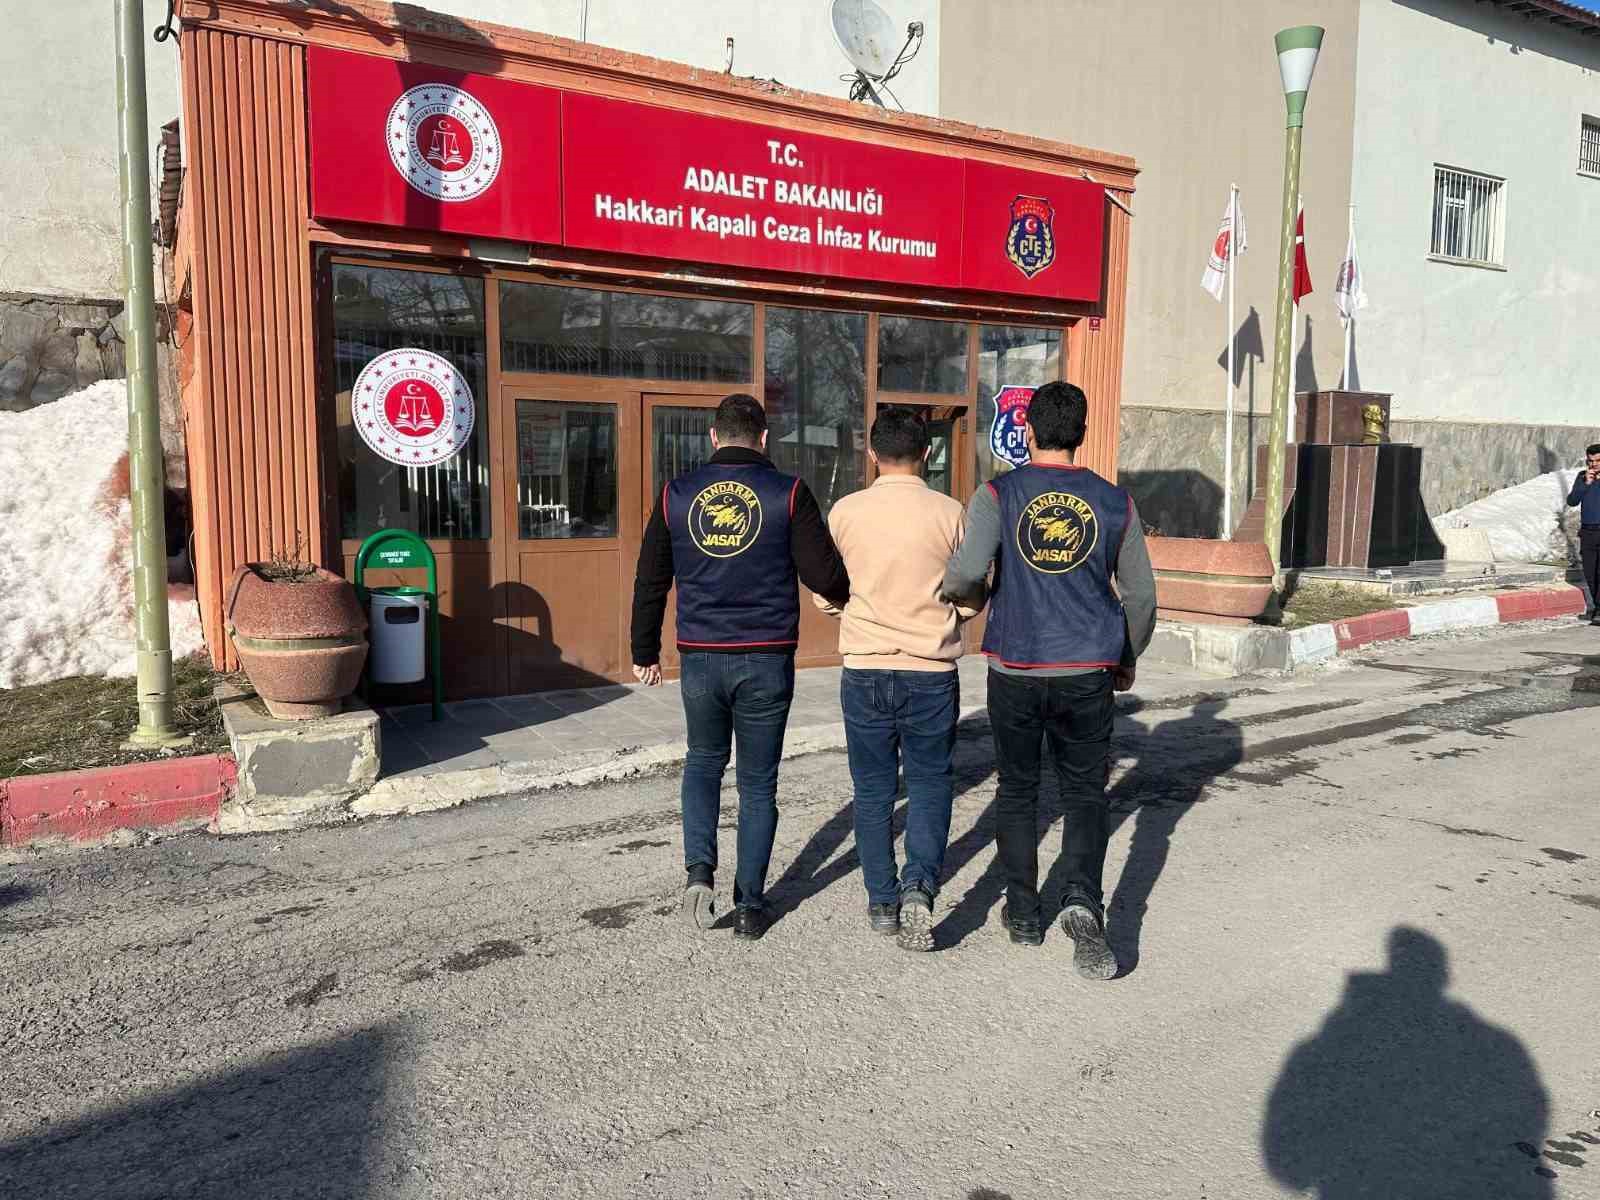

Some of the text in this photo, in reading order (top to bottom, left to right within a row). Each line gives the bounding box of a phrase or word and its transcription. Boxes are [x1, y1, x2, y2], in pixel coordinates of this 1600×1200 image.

[767, 140, 804, 168] T.C.
[684, 166, 883, 216] ADALET BAKANLIĞI
[595, 193, 937, 257] Hakkari Kapalı Ceza İnfaz Kurumu
[1020, 235, 1042, 257] CTE
[697, 484, 757, 508] JANDARMA
[1027, 494, 1092, 523] JANDARMA
[703, 534, 743, 547] JASAT
[1032, 549, 1074, 562] JASAT
